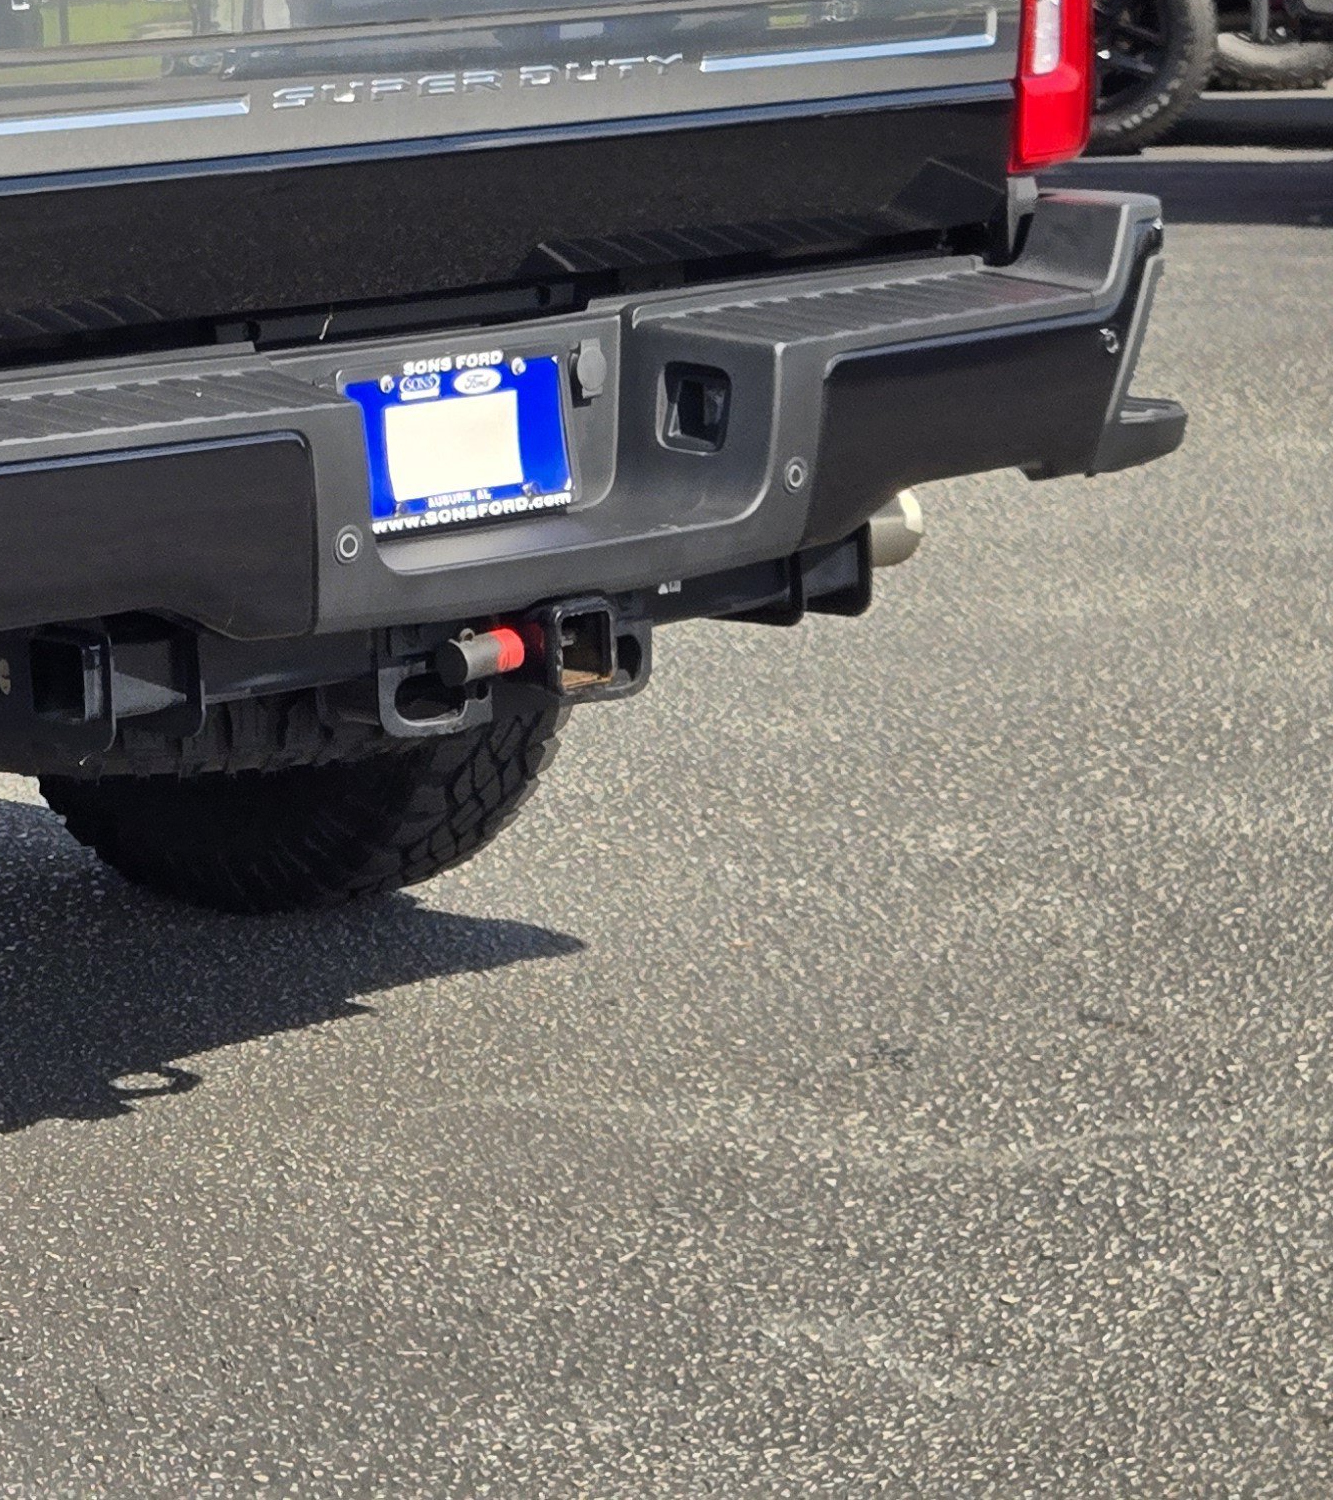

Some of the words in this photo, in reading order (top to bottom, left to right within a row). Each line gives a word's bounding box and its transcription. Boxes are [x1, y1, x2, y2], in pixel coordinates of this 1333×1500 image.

[273, 69, 503, 109] SUPER
[520, 53, 684, 87] DUTY
[403, 356, 452, 376] SONS
[456, 350, 504, 369] FORD
[372, 493, 572, 535] www.SONSFORD.com
